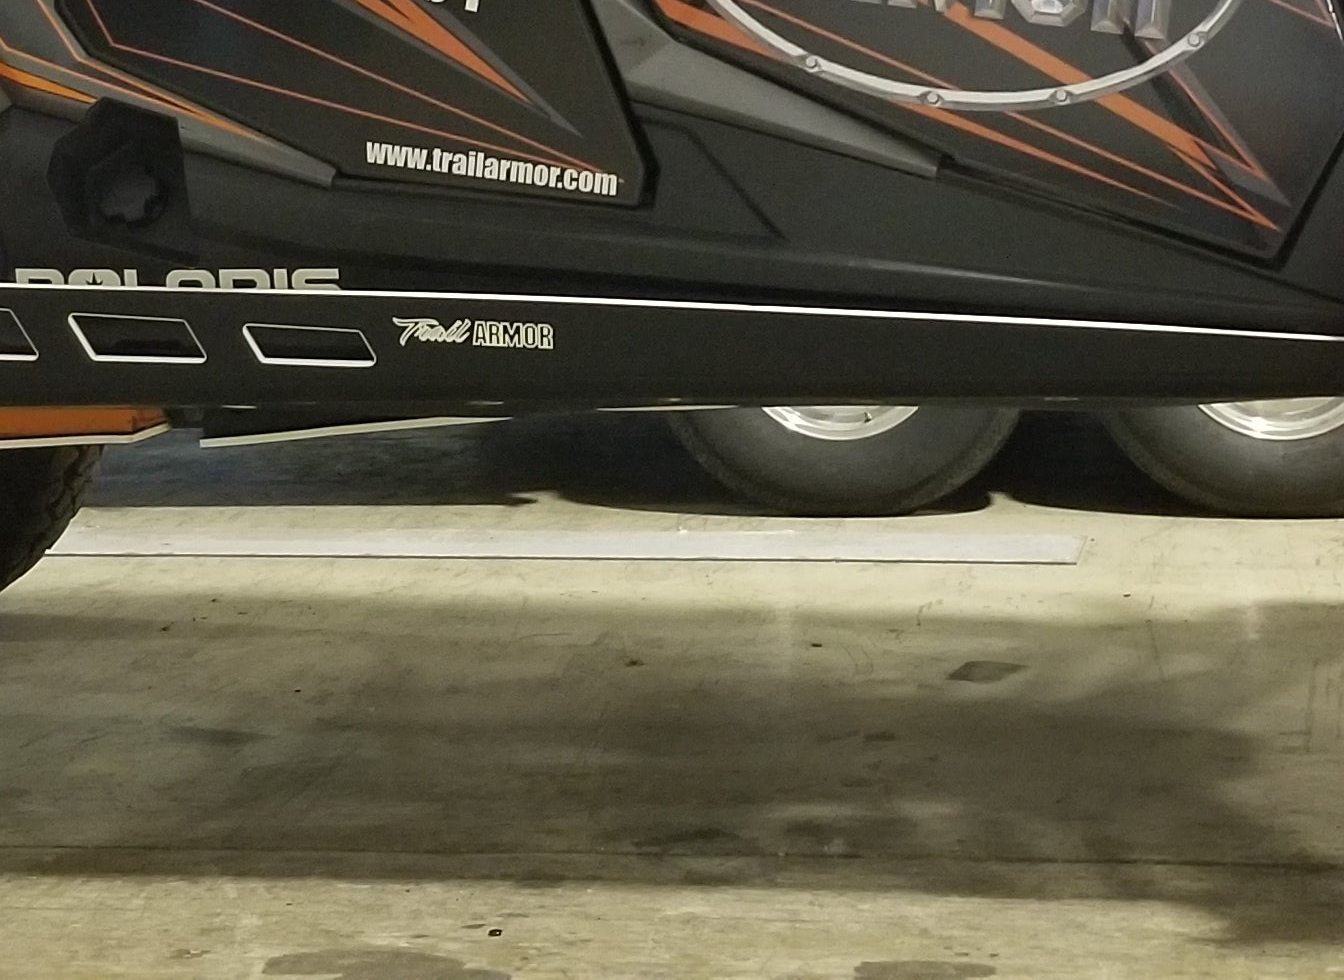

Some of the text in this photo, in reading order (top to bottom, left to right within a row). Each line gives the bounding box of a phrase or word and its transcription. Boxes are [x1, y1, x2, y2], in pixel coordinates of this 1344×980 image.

[366, 140, 618, 196] www.trailarmor.com
[392, 316, 554, 349] Trail ARMOR
